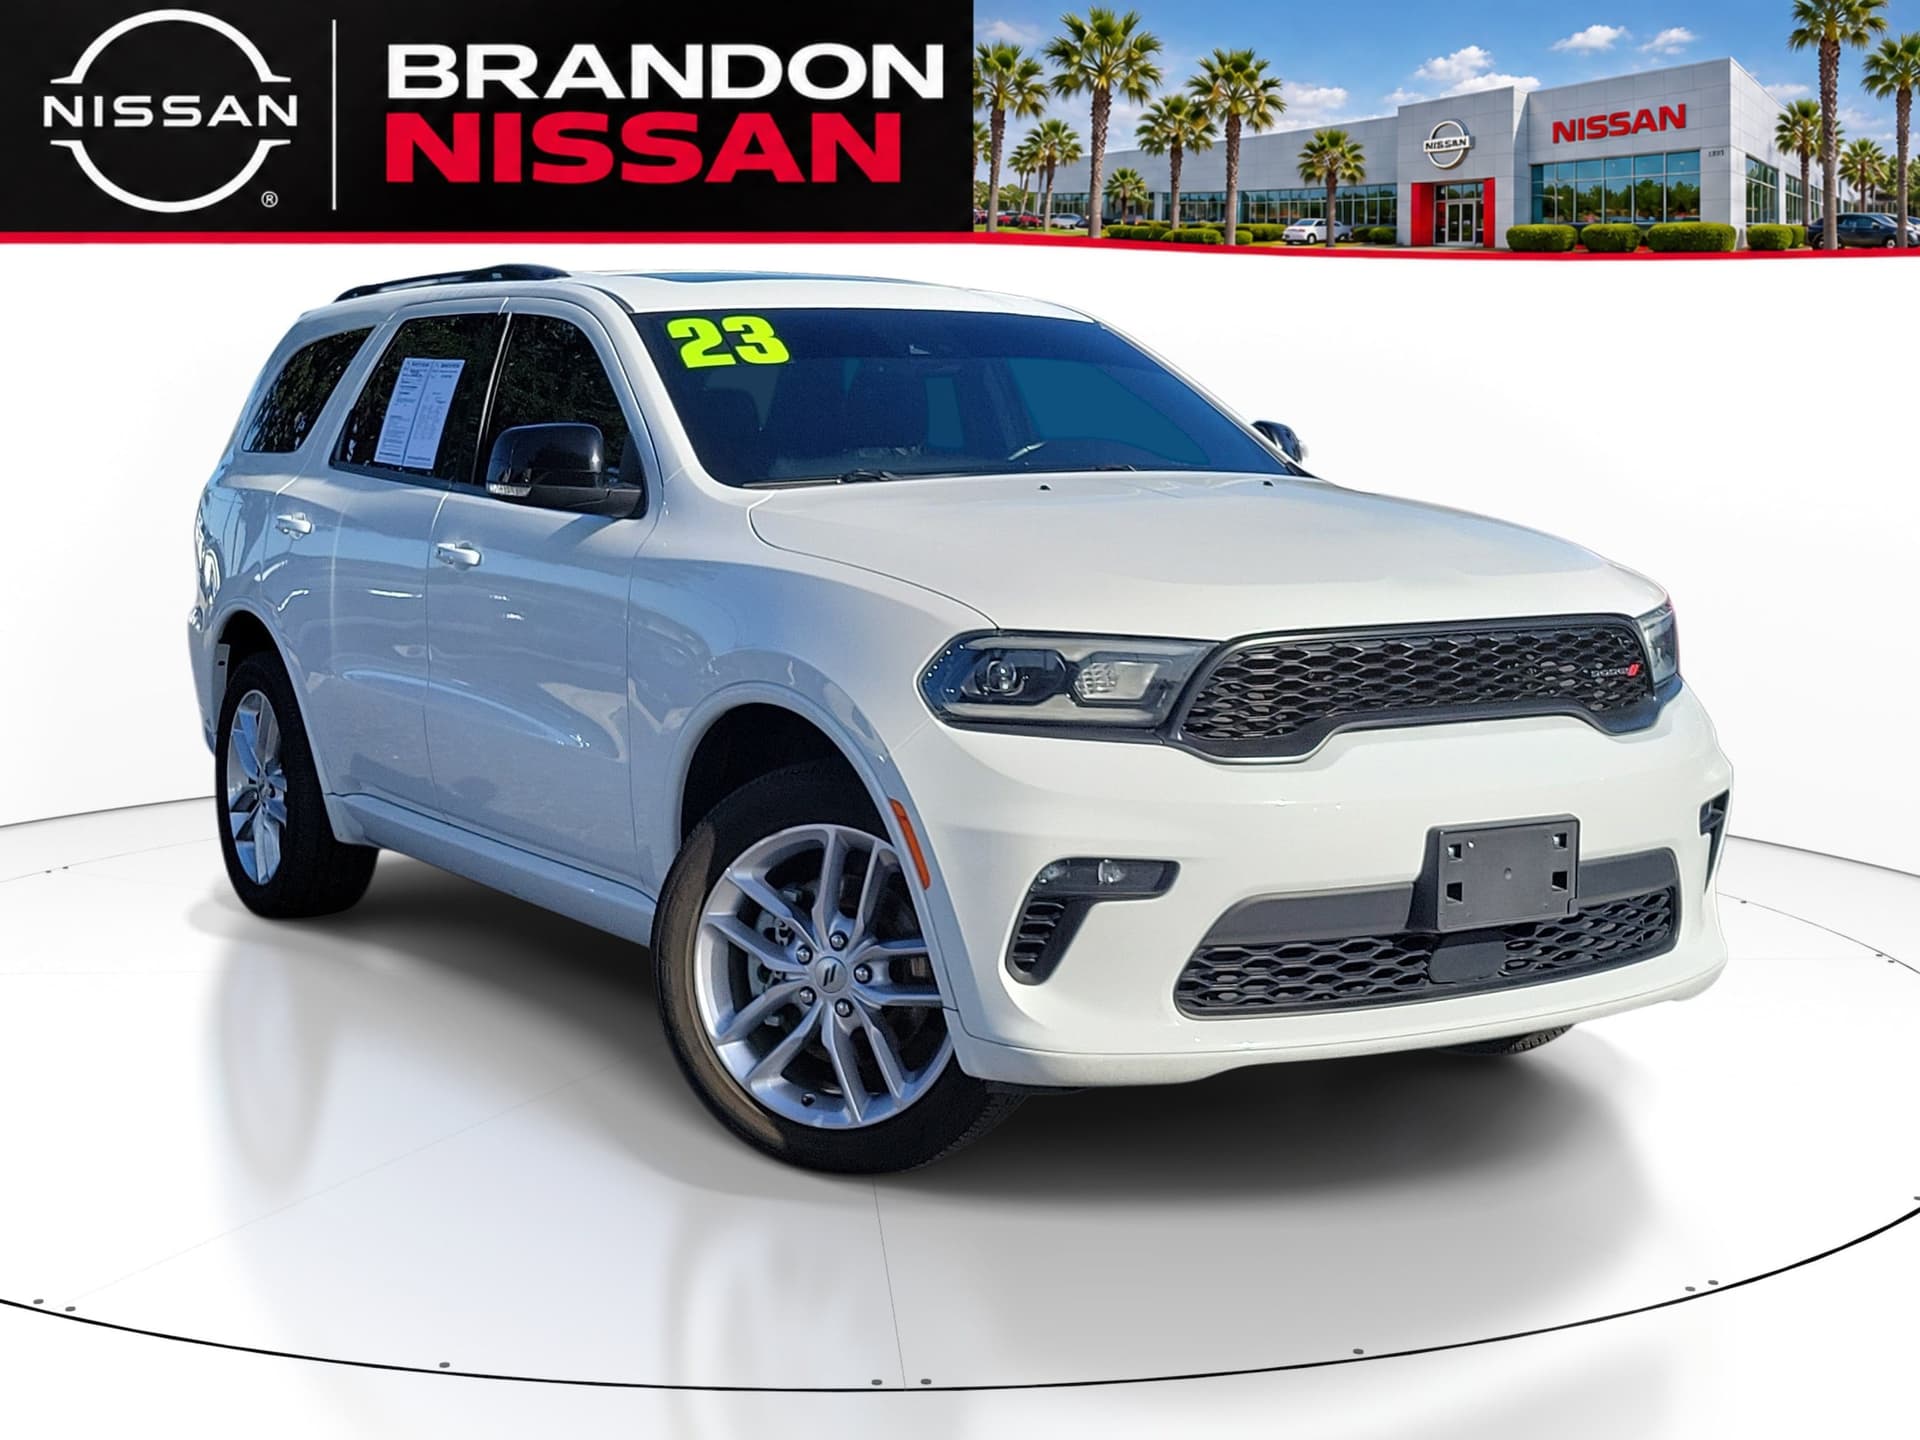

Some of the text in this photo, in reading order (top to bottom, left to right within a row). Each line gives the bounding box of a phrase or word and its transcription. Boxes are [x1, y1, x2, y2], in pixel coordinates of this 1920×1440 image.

[1425, 138, 1467, 150] NISSAN
[1552, 103, 1687, 144] NISSAN
[667, 314, 790, 369] 23
